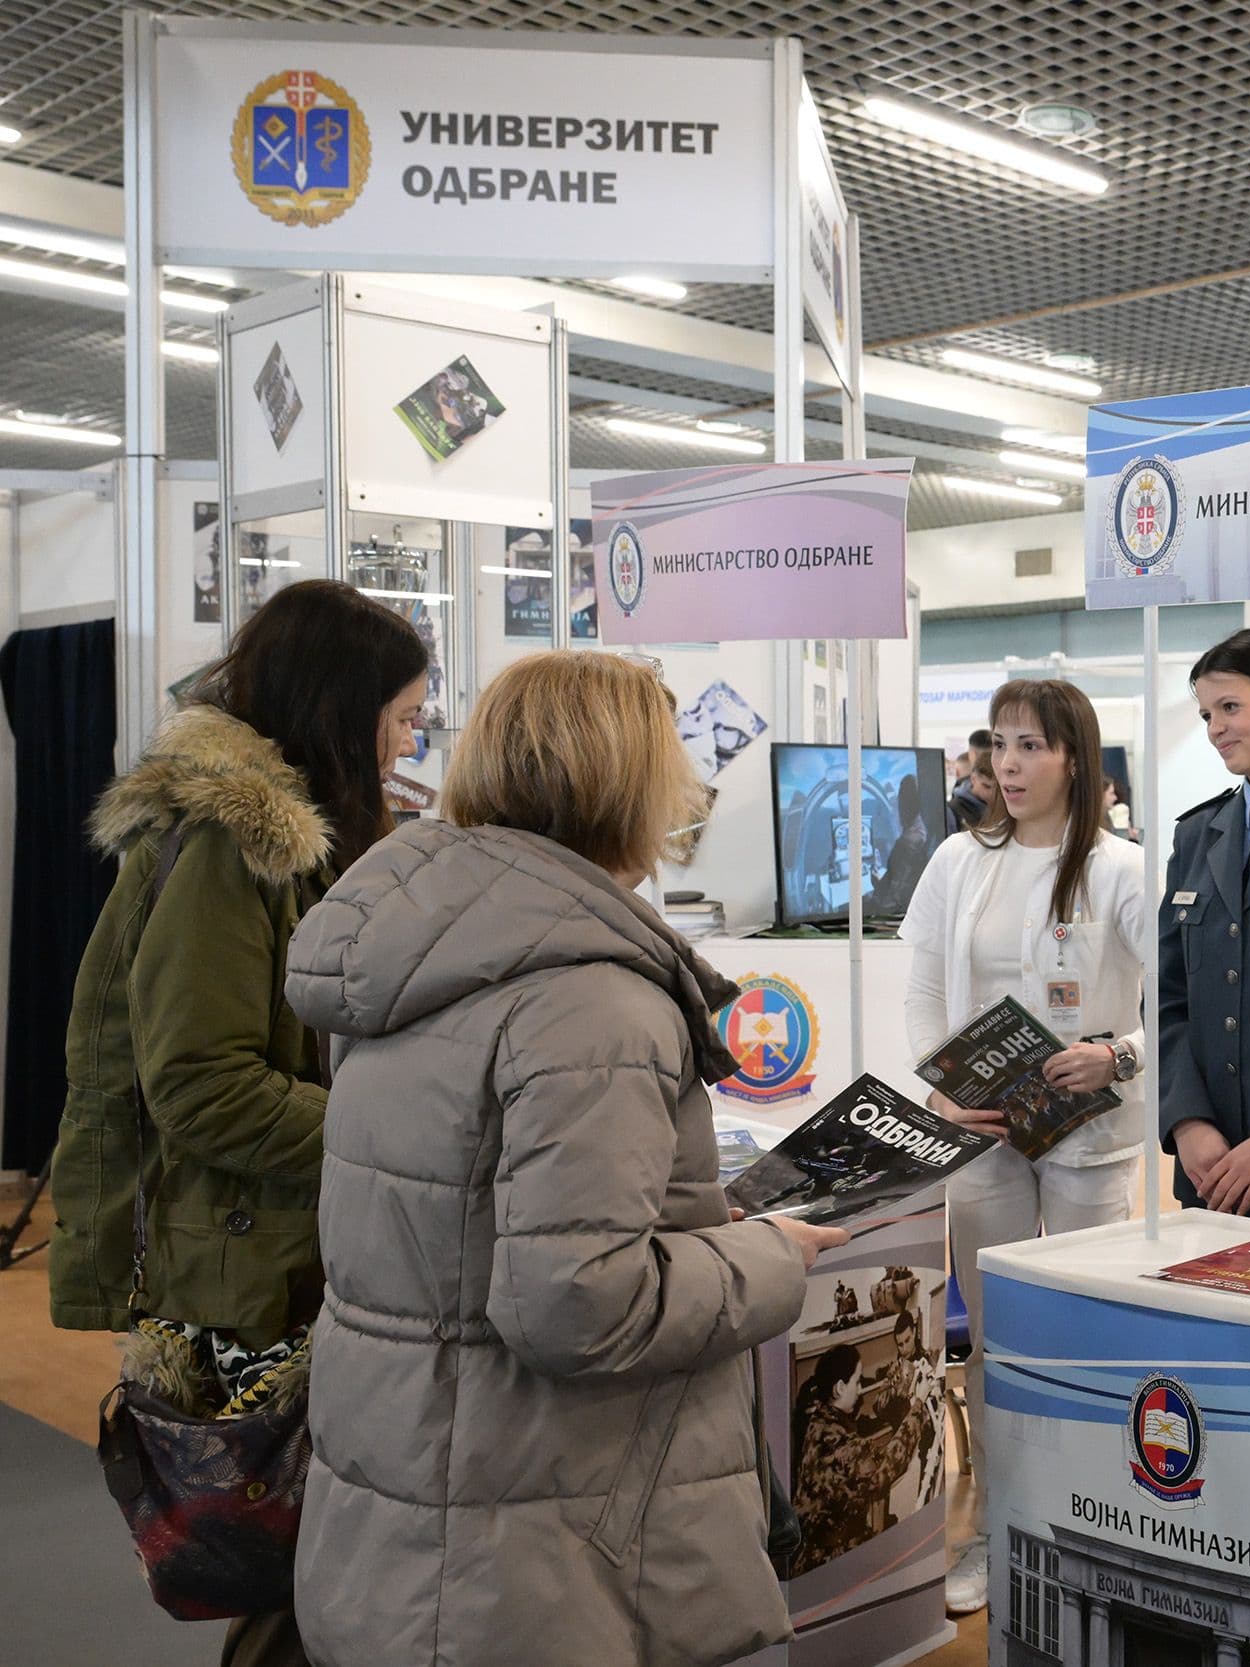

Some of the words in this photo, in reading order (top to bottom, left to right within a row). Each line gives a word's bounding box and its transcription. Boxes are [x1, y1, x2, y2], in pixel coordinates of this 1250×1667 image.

[400, 110, 719, 154] УНИВЕРЗИТЕТ
[402, 164, 617, 205] ОДБРАНЕ
[653, 549, 779, 575] МИНИСТАРСТВО
[784, 546, 873, 570] ОДБРАНЕ
[947, 690, 994, 701] МАРКОВИ
[969, 1012, 1003, 1041] ПРИЈАВИ
[1001, 1006, 1013, 1019] СЕ
[971, 1025, 1043, 1080] ВОЈНЕ
[1022, 1044, 1055, 1065] ШКОЛЕ
[849, 1102, 962, 1166] ОДБРАНА
[1158, 1461, 1175, 1472] 1970
[1071, 1493, 1133, 1535] ВОЈНА
[1096, 1572, 1135, 1601] ВОЈНА
[1142, 1586, 1229, 1627] ГИМНАЗИЈА
